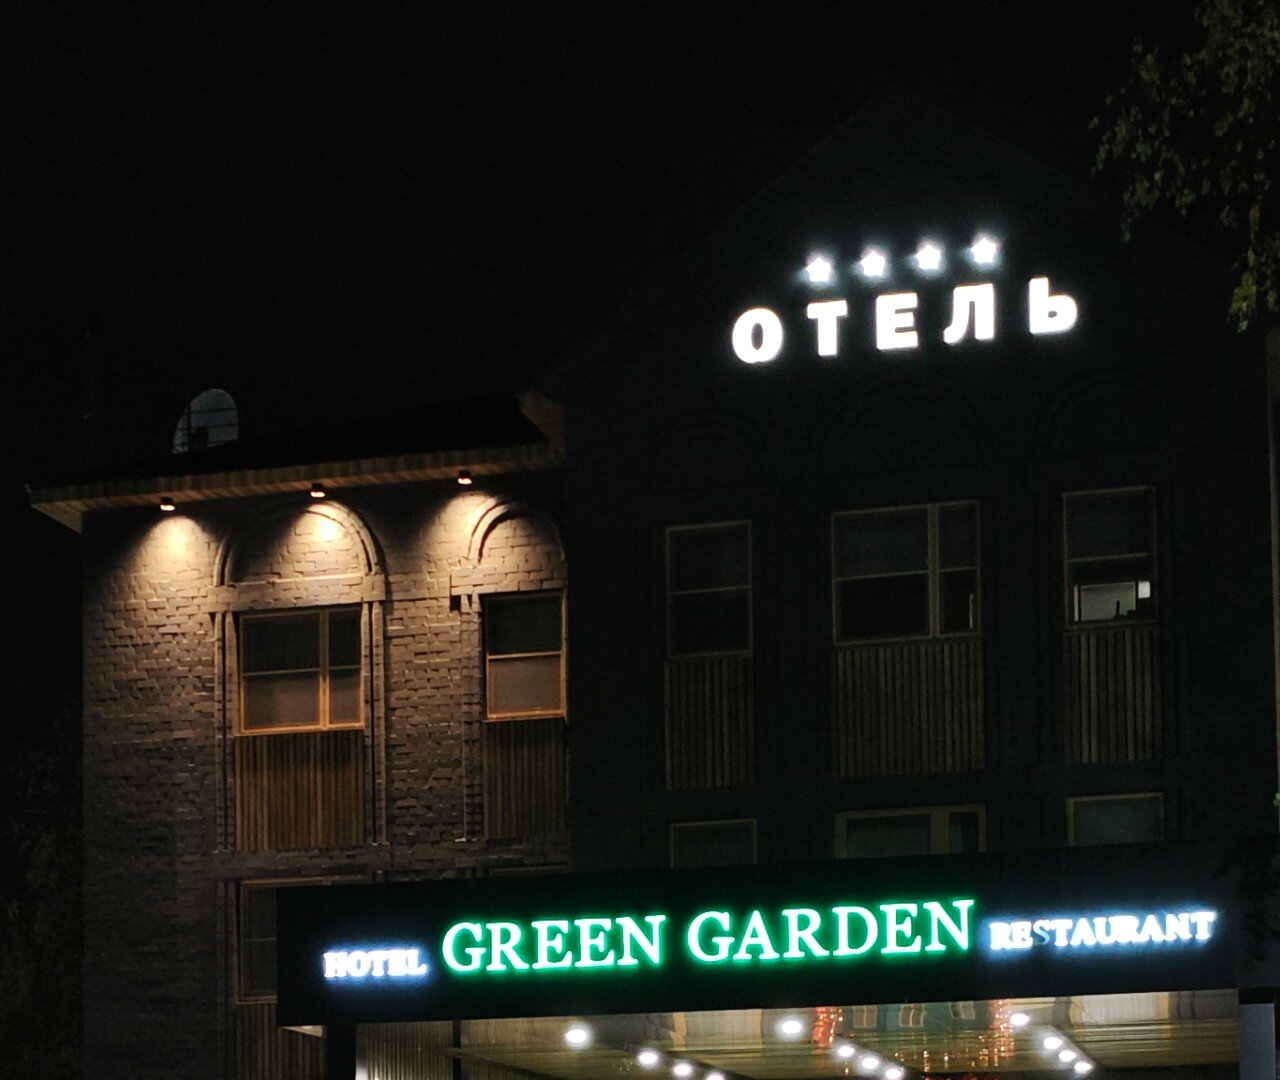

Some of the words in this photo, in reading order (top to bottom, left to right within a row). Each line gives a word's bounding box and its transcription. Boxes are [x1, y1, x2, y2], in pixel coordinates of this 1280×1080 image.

[732, 276, 1078, 364] ОТЕЛЬ
[323, 948, 427, 979] HOTEL
[441, 914, 666, 973] GREEN
[686, 899, 975, 964] GARDEN
[988, 910, 1217, 951] RESTAURANT
